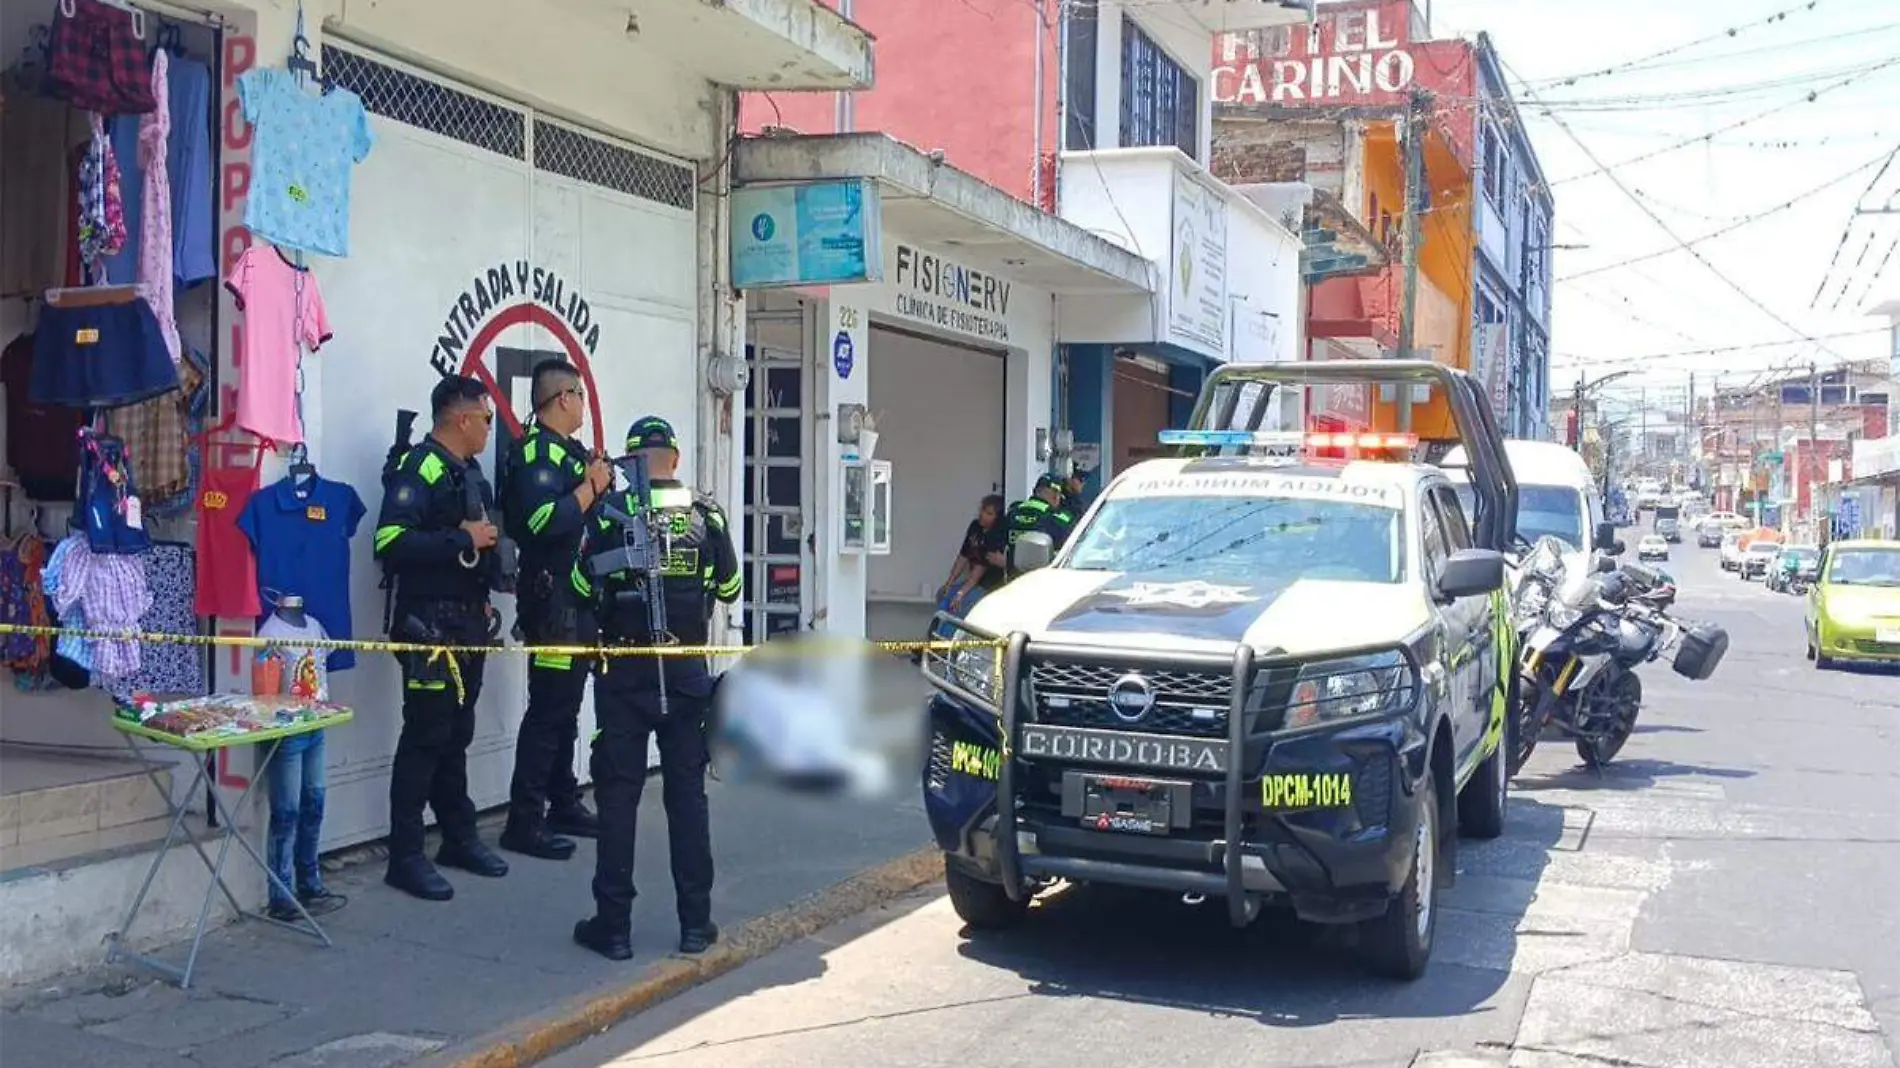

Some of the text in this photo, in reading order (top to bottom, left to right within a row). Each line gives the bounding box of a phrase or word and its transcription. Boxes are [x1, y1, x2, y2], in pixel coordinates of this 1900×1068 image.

[1223, 9, 1398, 62] HOTEL
[1210, 50, 1415, 102] CARIÑO
[897, 244, 1011, 315] FISIONERV
[430, 260, 600, 377] ENTRADA Y SALIDA
[937, 305, 949, 325] DE
[951, 309, 1010, 341] FISIOTERAPIA
[1024, 731, 1219, 770] CORDOBA
[1262, 773, 1352, 807] DPCM-1014
